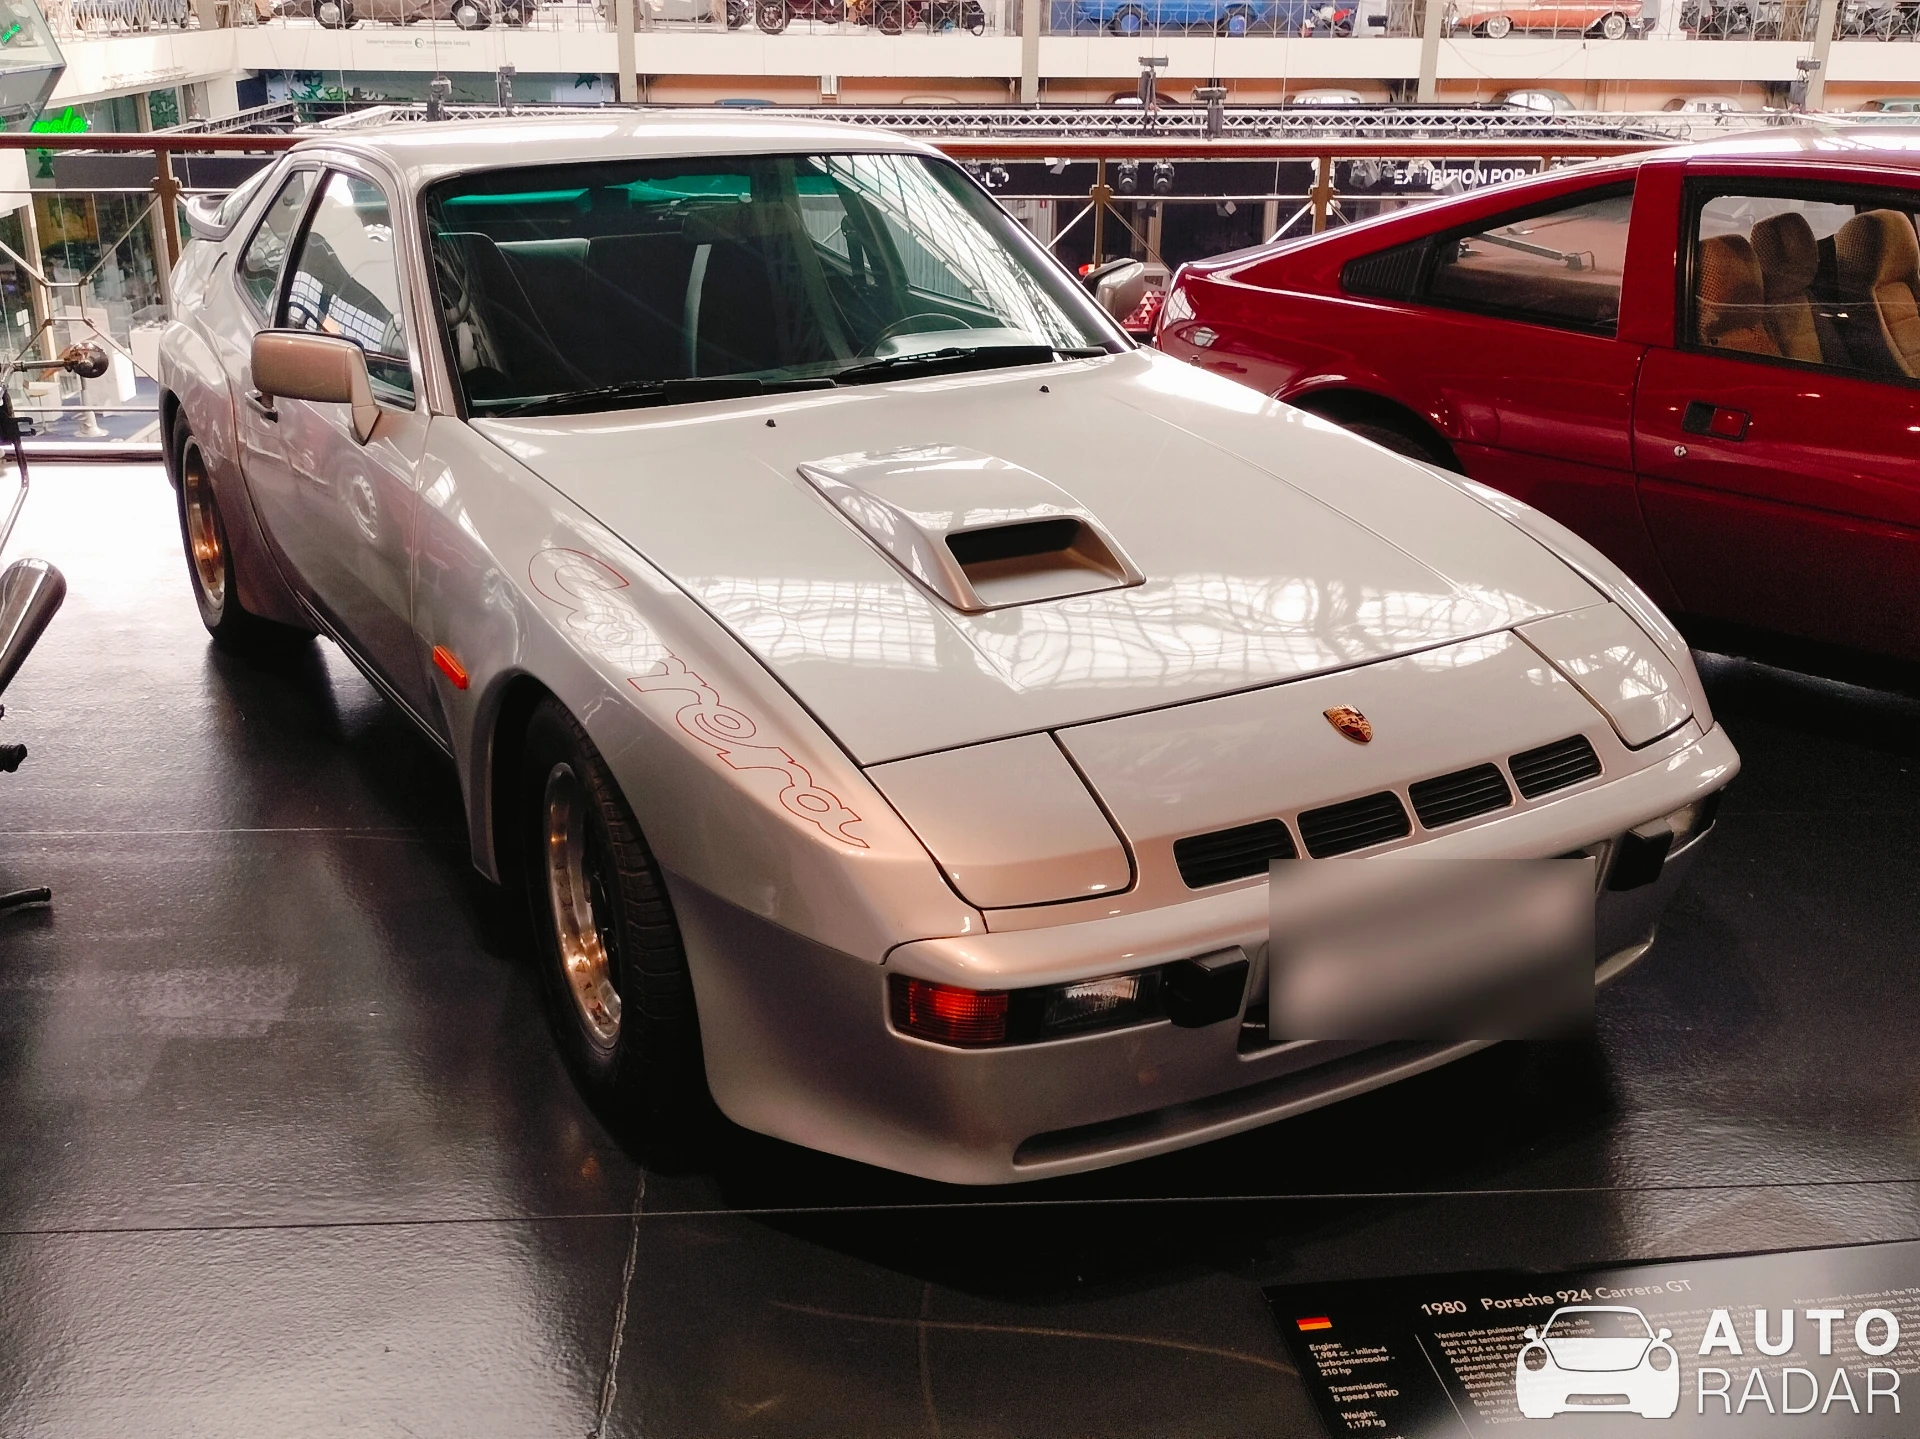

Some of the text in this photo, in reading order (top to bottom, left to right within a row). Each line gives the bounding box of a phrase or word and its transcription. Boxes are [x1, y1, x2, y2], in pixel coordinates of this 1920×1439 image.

[528, 547, 870, 849] Carrera
[1421, 1279, 1692, 1316] 1980 Porsche 924 Carrera GT
[1309, 1343, 1342, 1351] Engine:
[1328, 1382, 1387, 1393] Transmission:
[1342, 1392, 1369, 1402] speed
[1376, 1390, 1399, 1398] RWD
[1341, 1410, 1377, 1420] Weight:
[1373, 1419, 1386, 1427] kg
